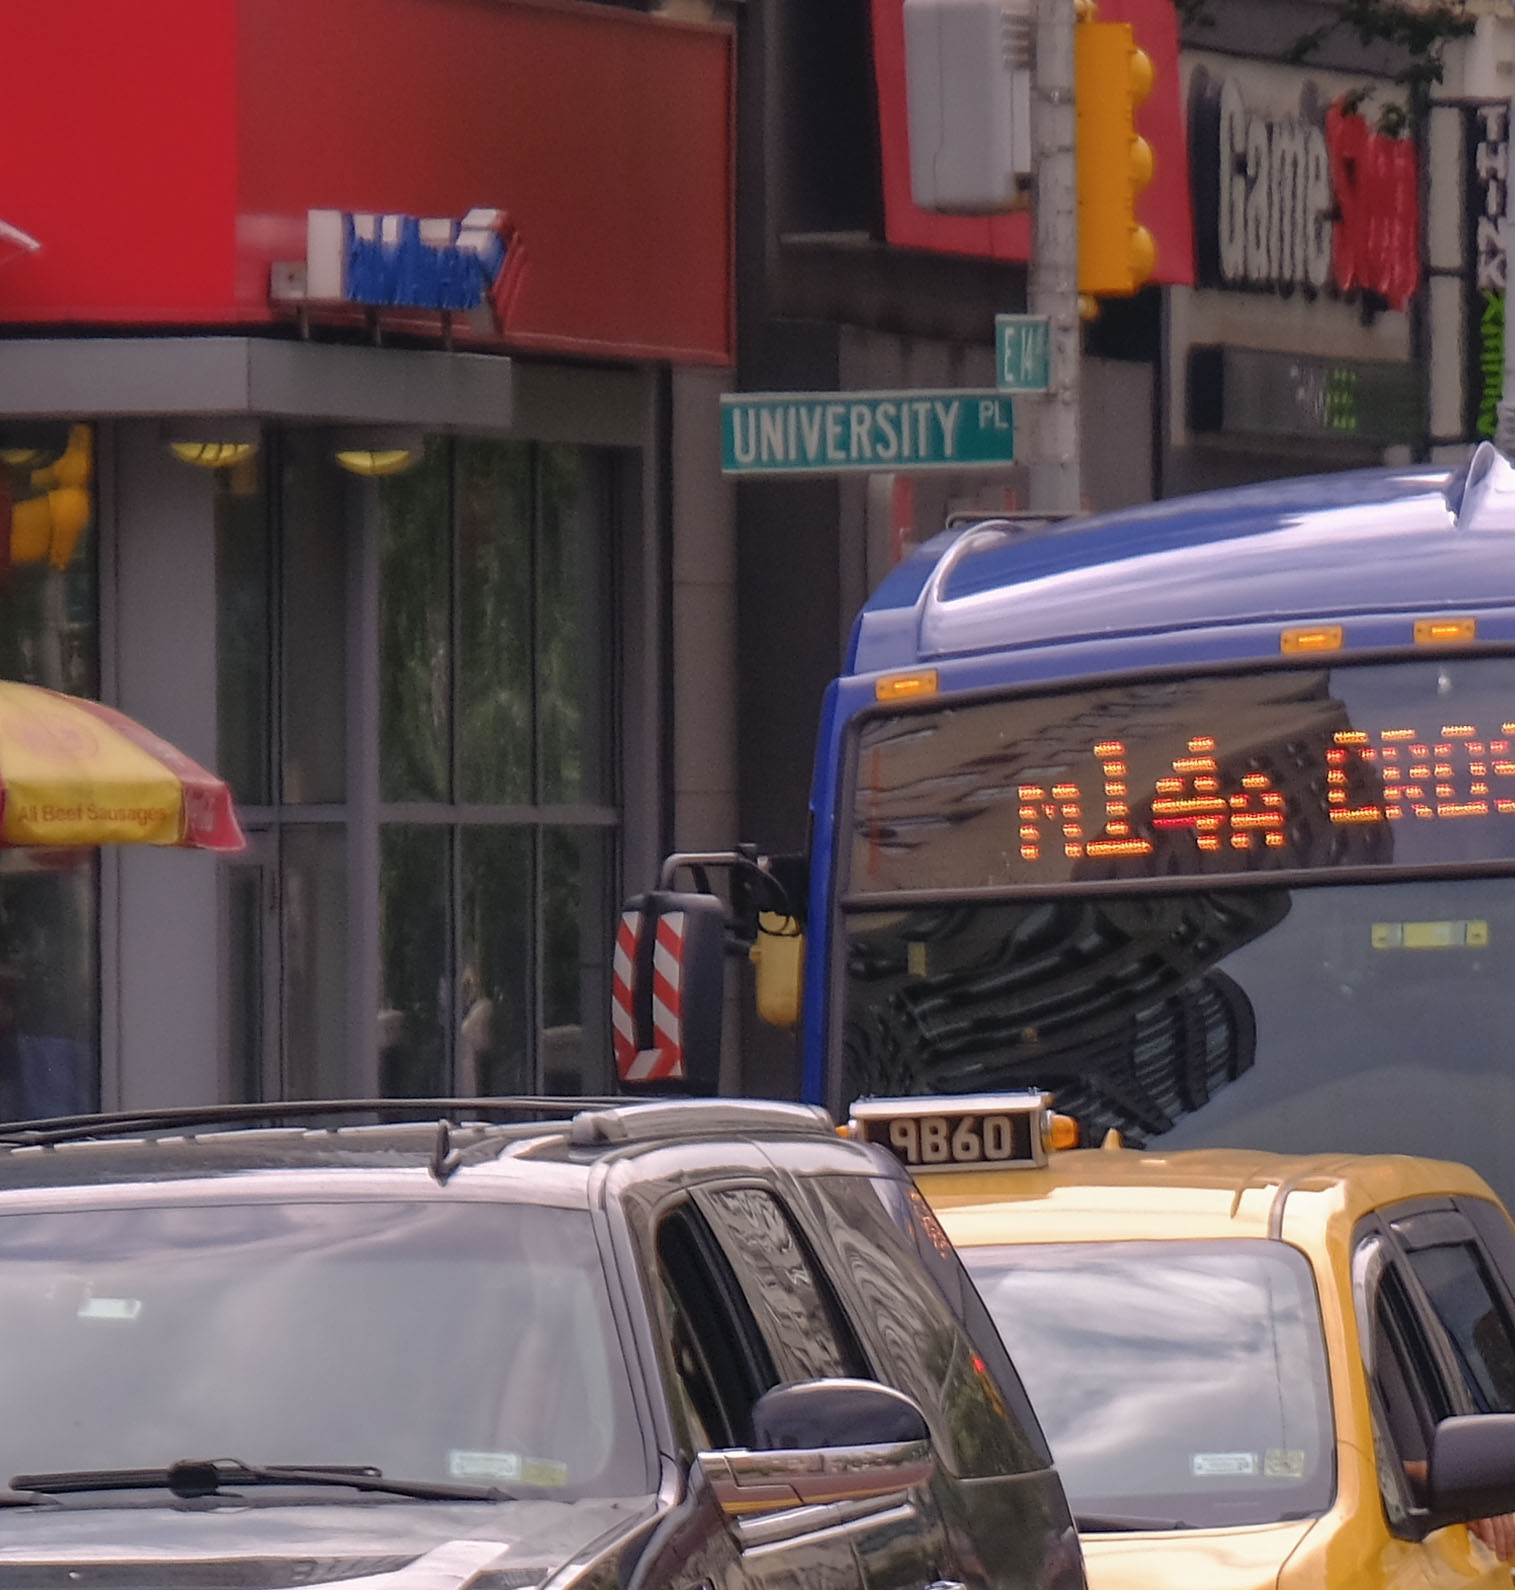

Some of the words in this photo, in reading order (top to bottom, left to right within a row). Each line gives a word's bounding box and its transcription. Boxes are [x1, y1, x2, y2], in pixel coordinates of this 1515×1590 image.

[1003, 325, 1016, 382] E
[732, 400, 960, 464] UNIVERSITY
[979, 400, 1011, 430] PL
[889, 1114, 1013, 1164] 9B60
